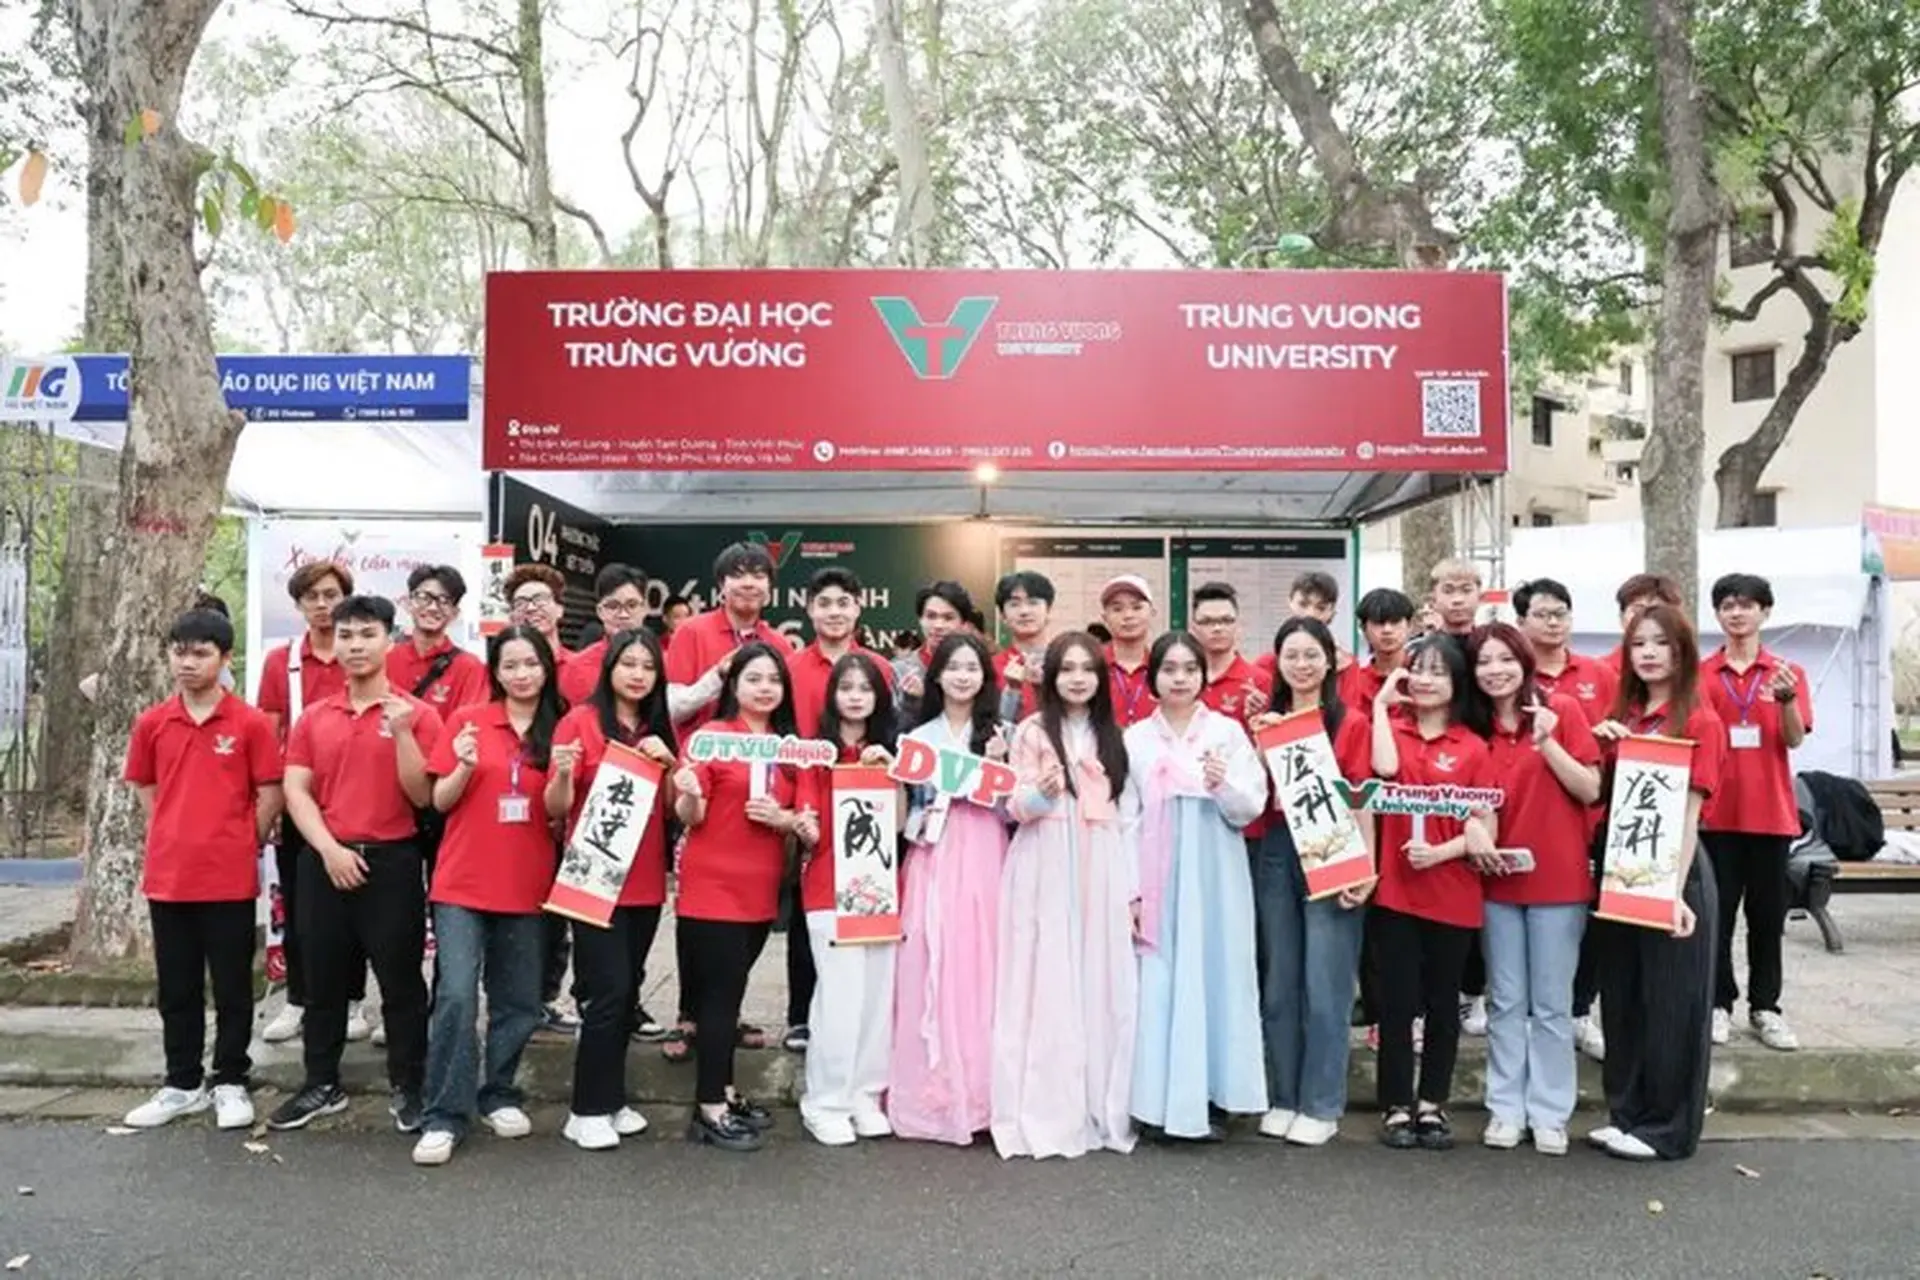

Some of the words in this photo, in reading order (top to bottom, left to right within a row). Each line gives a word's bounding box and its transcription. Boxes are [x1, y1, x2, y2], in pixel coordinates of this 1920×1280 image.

[548, 296, 686, 328] TRƯỜNG
[693, 303, 751, 333] ĐẠI
[760, 303, 833, 333] HỌC
[1180, 303, 1293, 329] TRUNG
[1300, 303, 1421, 329] VUONG
[566, 340, 677, 367] TRƯNG
[685, 340, 807, 367] VƯƠNG
[1207, 344, 1398, 369] UNIVERSITY
[7, 366, 67, 397] IIG
[222, 368, 250, 391] ÁO
[255, 373, 299, 395] DỤC
[303, 374, 331, 391] IIG
[336, 369, 381, 395] VIỆT
[386, 373, 435, 391] NAM
[528, 503, 559, 566] 04
[892, 738, 1017, 805] DVP
[1372, 799, 1468, 817] University
[1617, 769, 1673, 860] 登科
